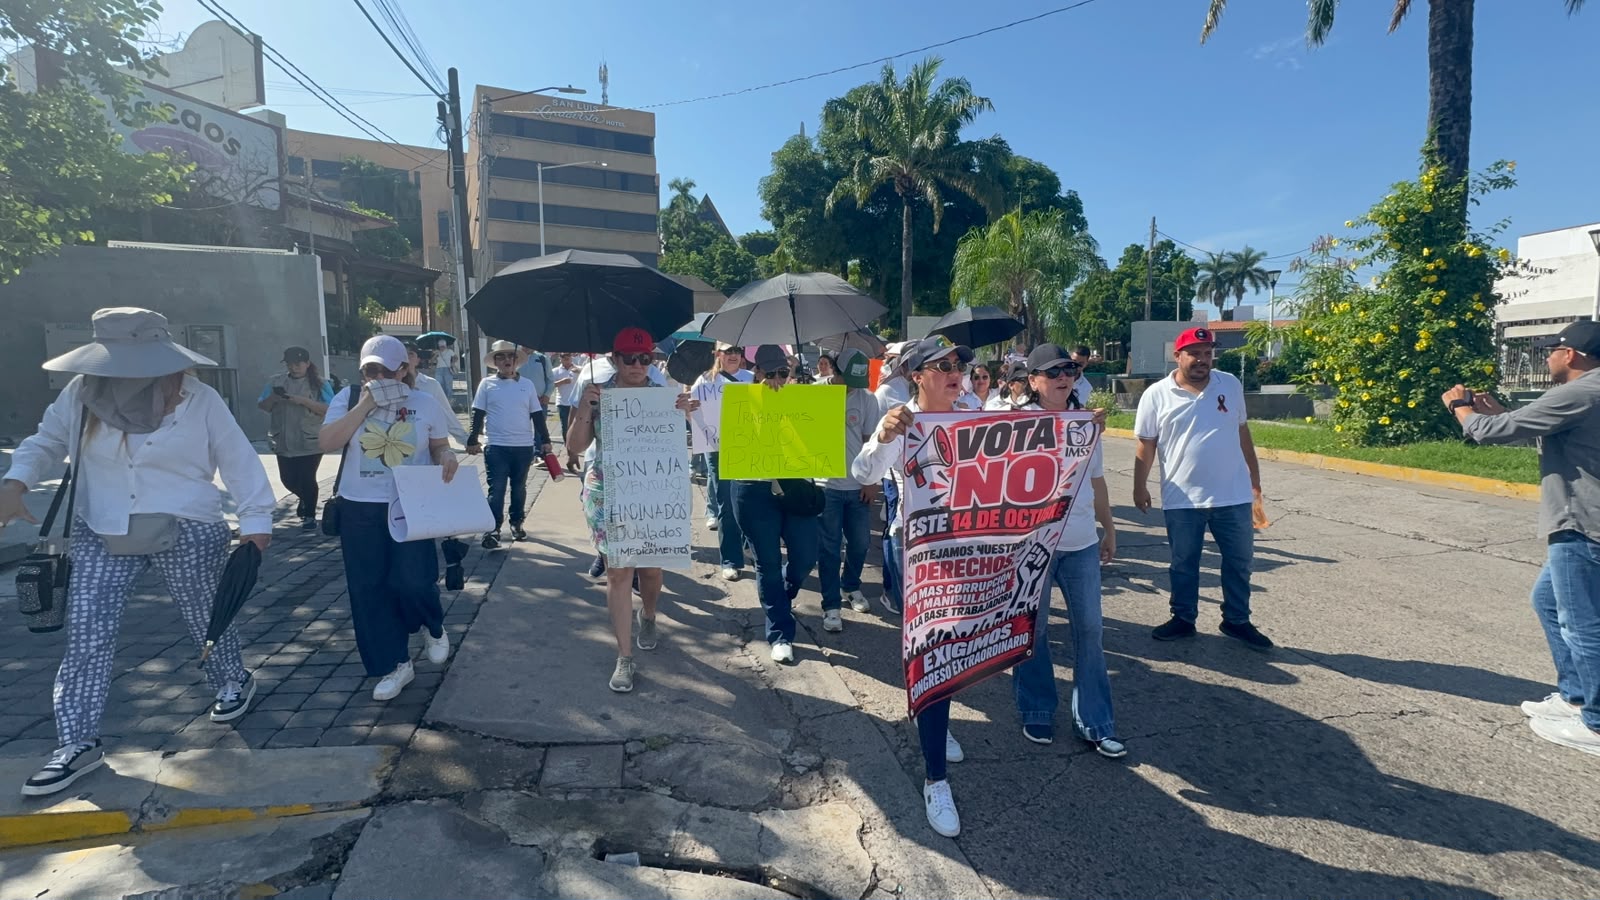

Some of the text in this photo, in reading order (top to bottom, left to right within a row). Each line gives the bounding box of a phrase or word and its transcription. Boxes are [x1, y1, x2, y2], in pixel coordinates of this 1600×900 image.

[552, 99, 599, 112] SAN LUIS
[609, 397, 642, 419] +10
[731, 400, 816, 424] TRABAJAMOS
[624, 423, 675, 436] GRAVES
[727, 426, 795, 448] BAJO
[956, 416, 1057, 461] VOTA
[1065, 446, 1091, 457] IMSS
[612, 460, 647, 477] SIN
[952, 453, 1059, 509] NO
[608, 502, 687, 523] HACINADOS
[616, 524, 682, 541] Jubilados
[908, 512, 948, 540] ESTE
[951, 511, 972, 530] 14
[976, 509, 999, 529] DE
[621, 544, 689, 556] MEDICAMENTOS
[642, 541, 657, 549] SIN
[908, 541, 1026, 567] PROTEJAMOS NUESTROS
[907, 591, 918, 608] NO
[919, 585, 945, 599] MAS
[909, 591, 1013, 633] A LA BASE TRABAJADORA
[915, 602, 922, 614] Y
[923, 623, 1013, 674] EXIGIMOS
[911, 632, 1029, 703] CONGRESO EXTRAORDINARIO
